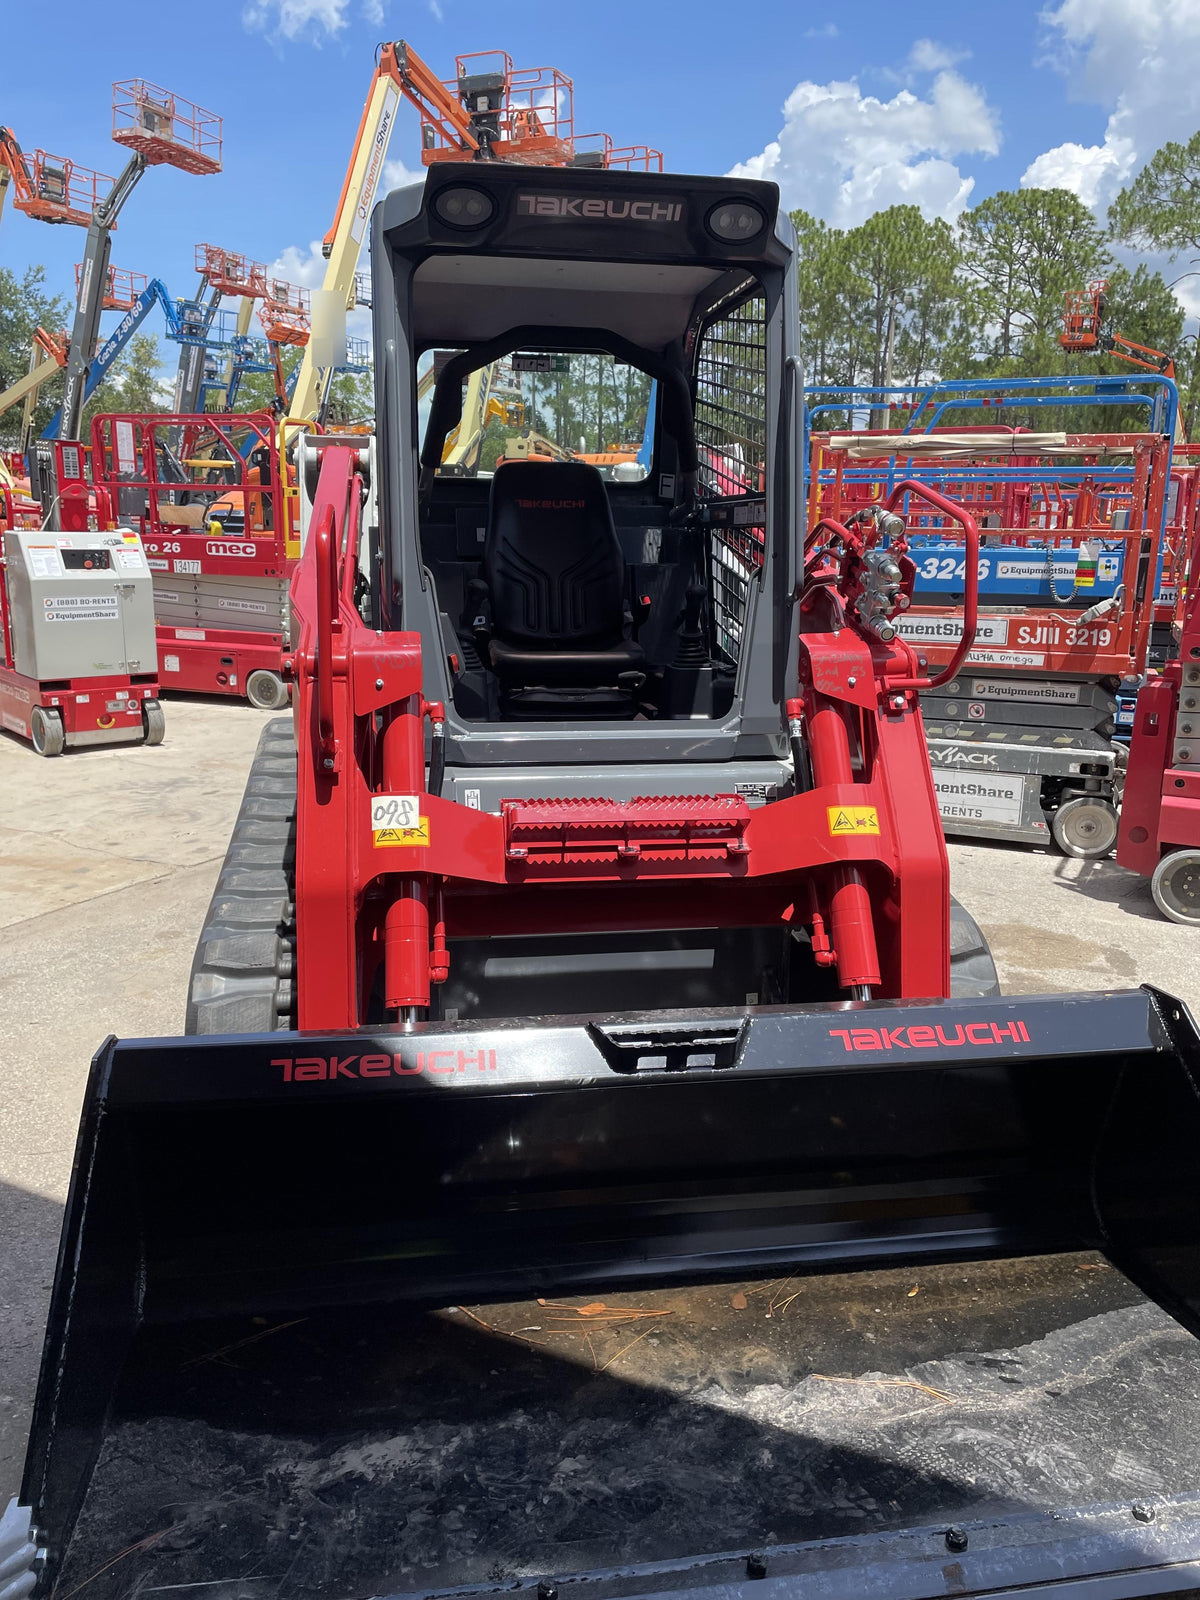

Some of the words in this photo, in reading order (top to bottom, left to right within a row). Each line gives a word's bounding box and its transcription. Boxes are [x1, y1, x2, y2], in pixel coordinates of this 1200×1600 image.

[361, 110, 391, 206] EquipmentShare
[519, 196, 682, 221] TAKEUCHI
[115, 300, 143, 341] Z-80/60
[516, 499, 585, 509] TAKEUCHI
[163, 542, 181, 553] 26
[208, 542, 256, 556] mec
[175, 560, 200, 573] 134177
[1010, 566, 1077, 576] EquipmetSha
[56, 611, 116, 620] EquipmentShare
[1066, 628, 1111, 646] 3219
[987, 685, 1077, 699] EquipmentShare
[374, 799, 414, 826] 098
[829, 1020, 1032, 1051] TAKEUCHI
[270, 1049, 498, 1082] TAKEUCHI
